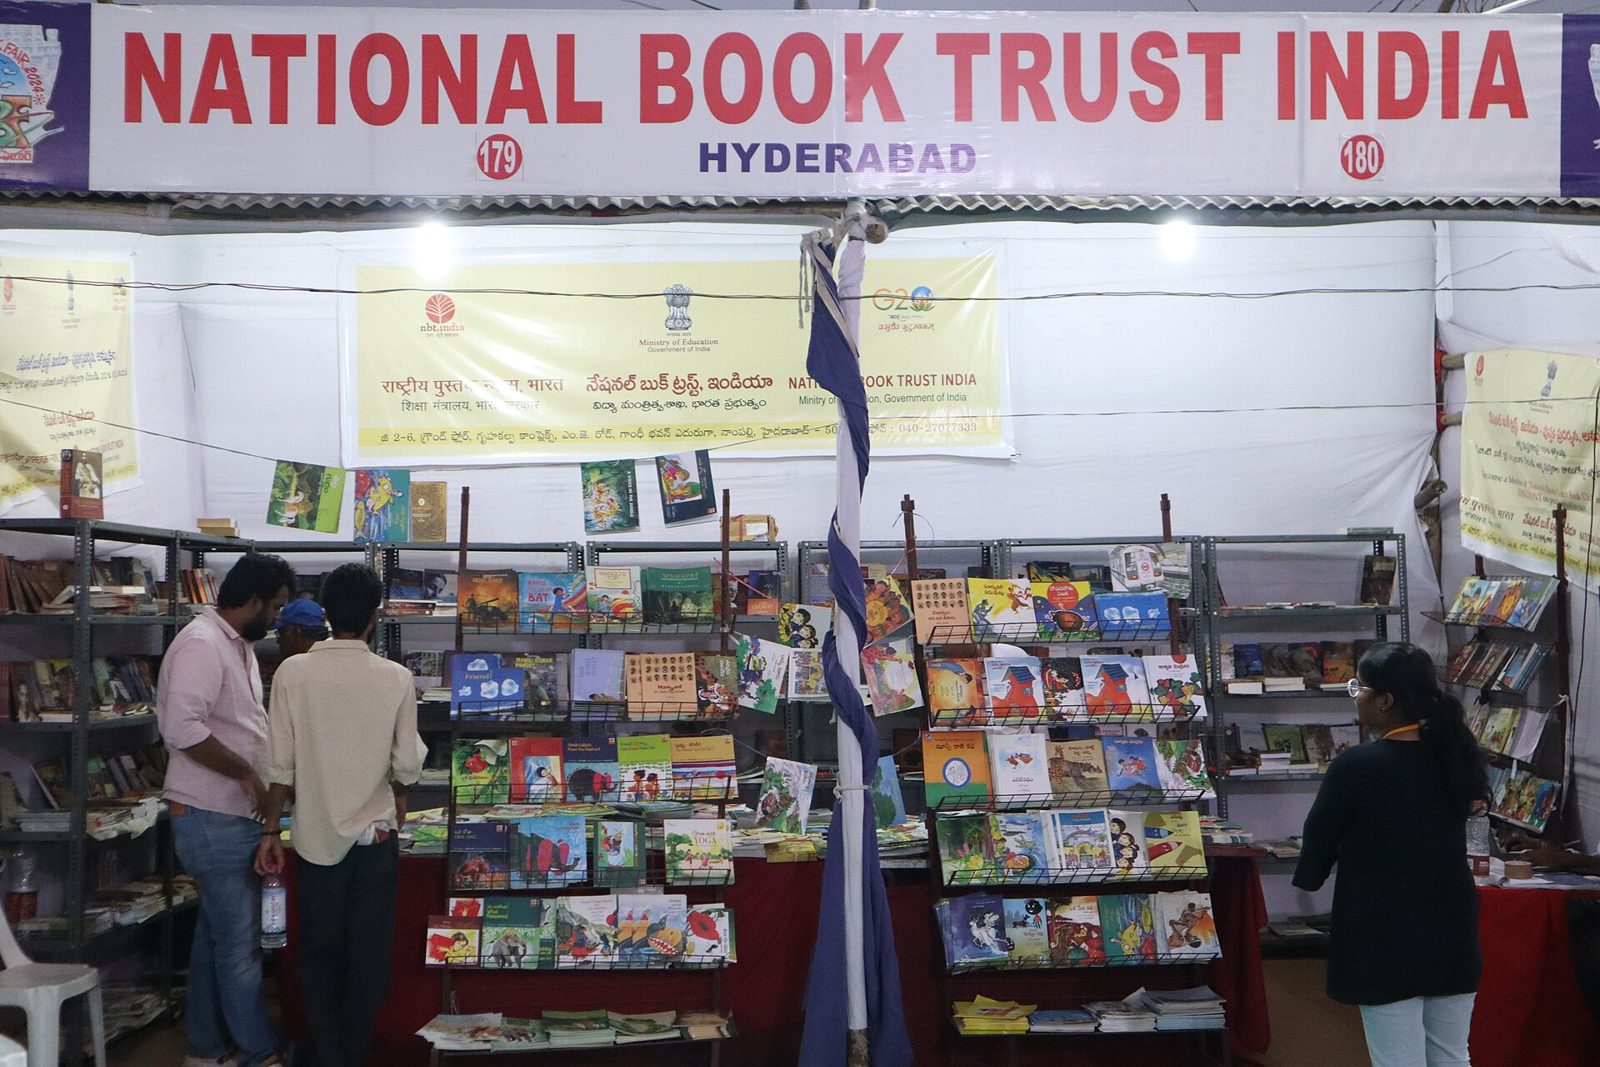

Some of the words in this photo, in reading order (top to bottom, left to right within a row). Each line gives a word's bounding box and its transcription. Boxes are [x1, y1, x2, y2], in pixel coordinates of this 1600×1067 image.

[4, 42, 30, 69] FAIR
[24, 67, 45, 92] 2024
[124, 33, 604, 126] NATIONAL
[639, 31, 904, 124] BOOK
[936, 31, 1240, 123] TRUST
[1277, 29, 1529, 121] INDIA
[480, 140, 519, 174] 179
[699, 142, 977, 173] HYDERABAD
[1344, 140, 1380, 174] 180
[639, 339, 669, 347] Ministry
[381, 376, 428, 396] राष्ट्रीय
[527, 379, 564, 391] भारत
[586, 373, 636, 394] నేషనల్
[640, 373, 669, 391] బుక్
[671, 374, 703, 397] ట్రస్ట్,
[708, 372, 773, 390] ఇండియా
[861, 376, 894, 387] OOK
[897, 375, 937, 387] TRUST
[941, 374, 977, 386] INDIA
[401, 399, 427, 411] शिक्षा
[433, 400, 472, 411] मंत्रालय,
[476, 401, 500, 410] भार
[593, 401, 617, 413] విద్యా
[692, 399, 720, 409] భారత
[724, 398, 767, 410] ప్రభుత్వం
[799, 396, 826, 407] Minitry
[884, 393, 934, 403] Government
[936, 393, 945, 402] of
[946, 392, 967, 402] India
[393, 433, 415, 442] 2-6,
[476, 431, 515, 445] గృహకల్ప
[595, 428, 615, 439] రోడ్,
[620, 427, 644, 439] గాంధీ
[648, 427, 671, 438] భవన్
[675, 428, 716, 438] ఎదురుగా,
[721, 427, 755, 439] నాంపల్లి,
[899, 423, 977, 433] 040-27077333
[528, 592, 549, 602] BAT
